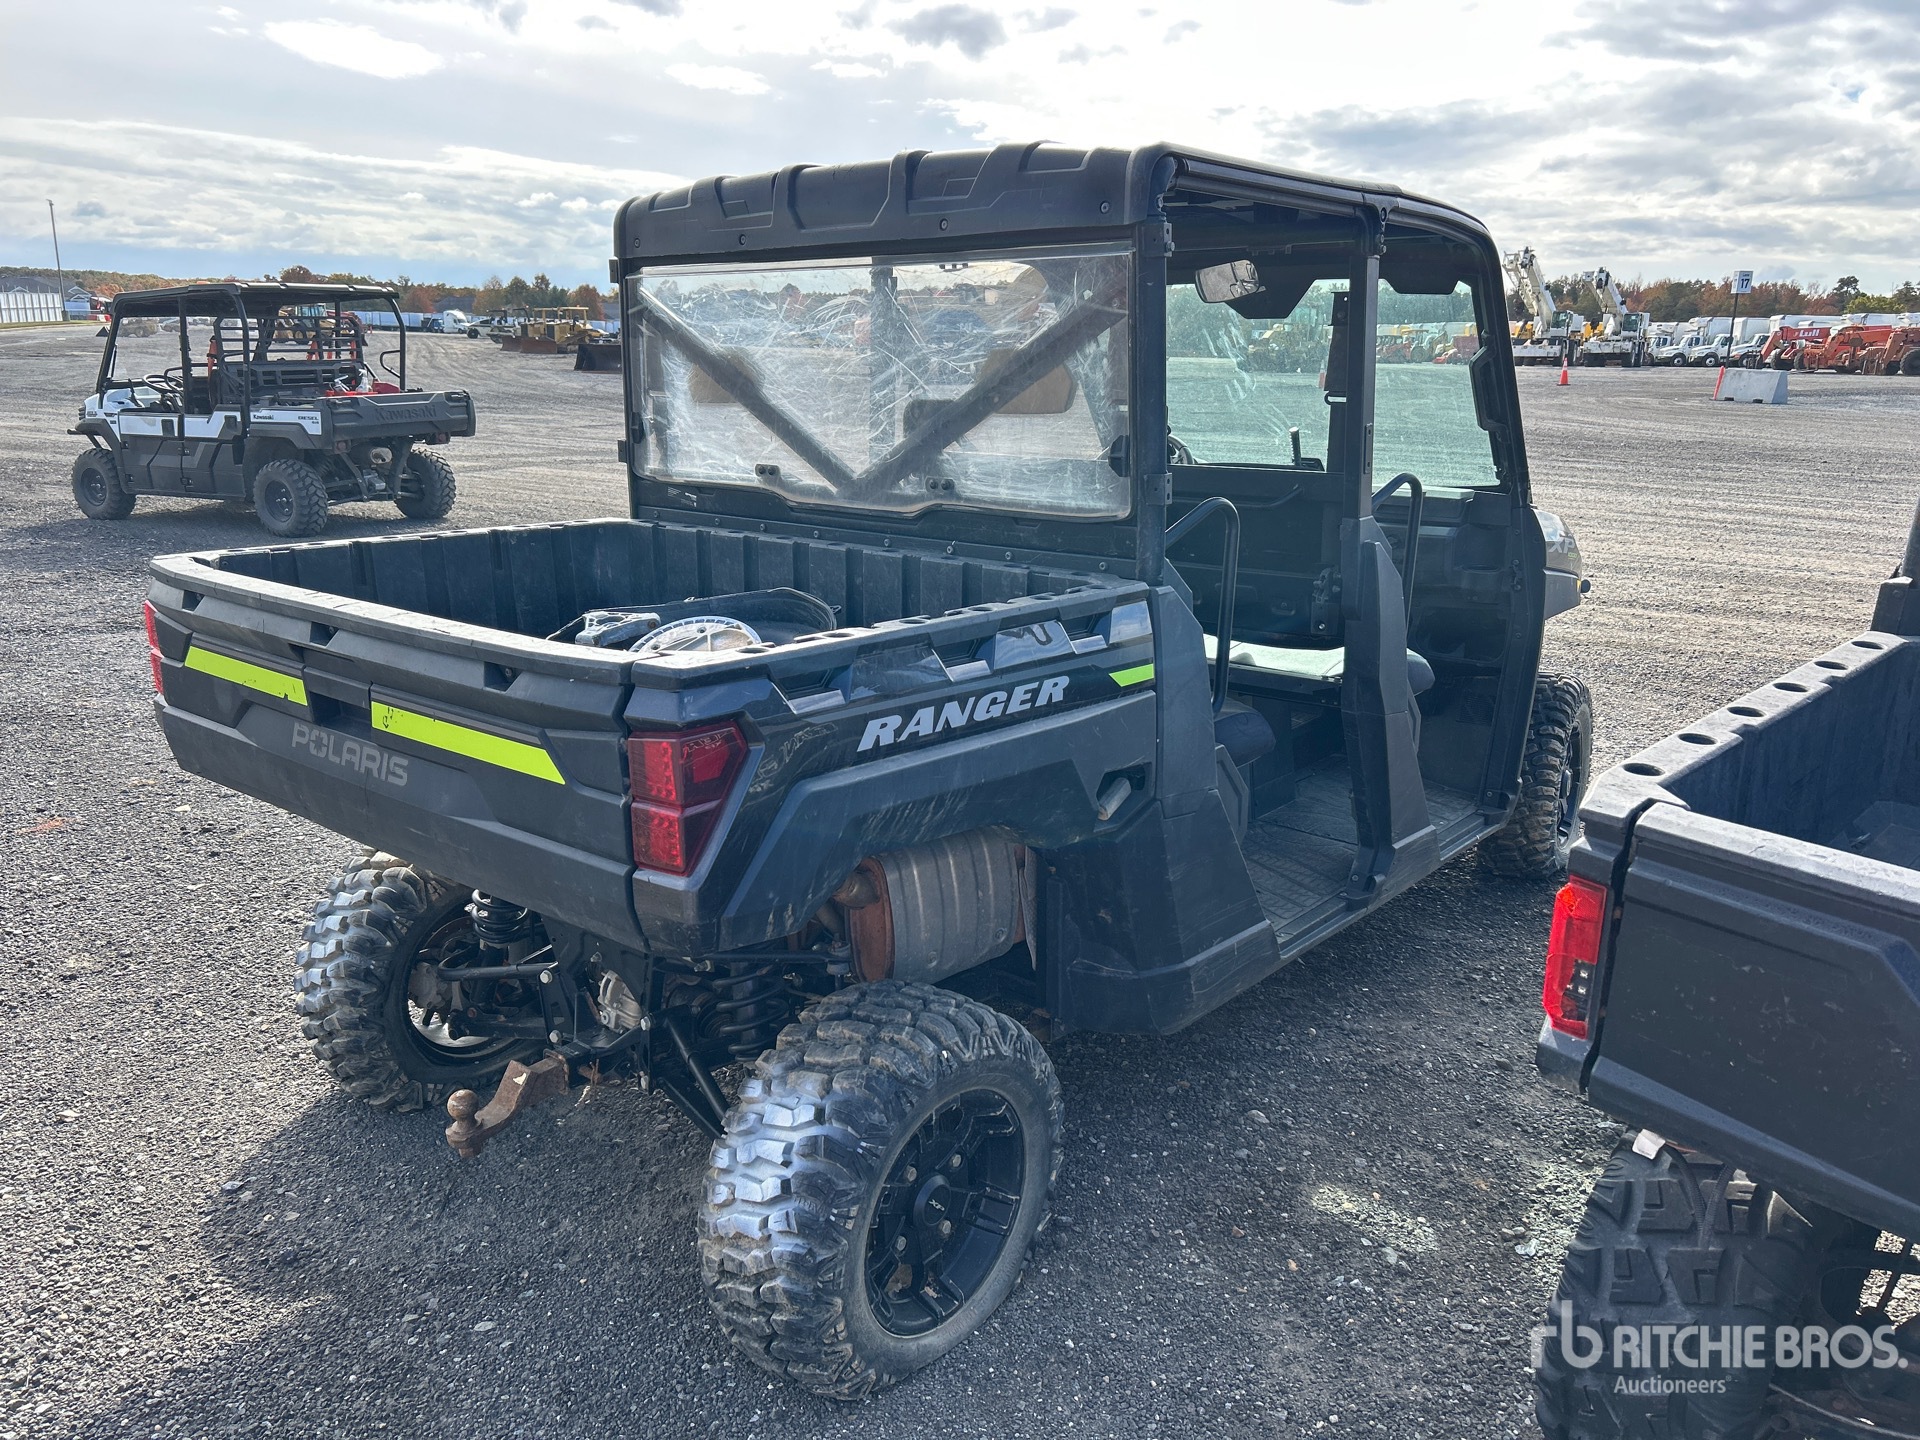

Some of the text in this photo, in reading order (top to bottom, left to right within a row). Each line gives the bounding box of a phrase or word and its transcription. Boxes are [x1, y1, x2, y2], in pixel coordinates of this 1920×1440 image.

[1741, 278, 1750, 288] 17
[1799, 329, 1820, 337] Lull
[374, 405, 437, 421] Kawasaki
[1548, 537, 1576, 554] XP
[857, 675, 1069, 751] RANGER
[292, 722, 409, 787] POLARIS
[928, 1199, 945, 1211] XP
